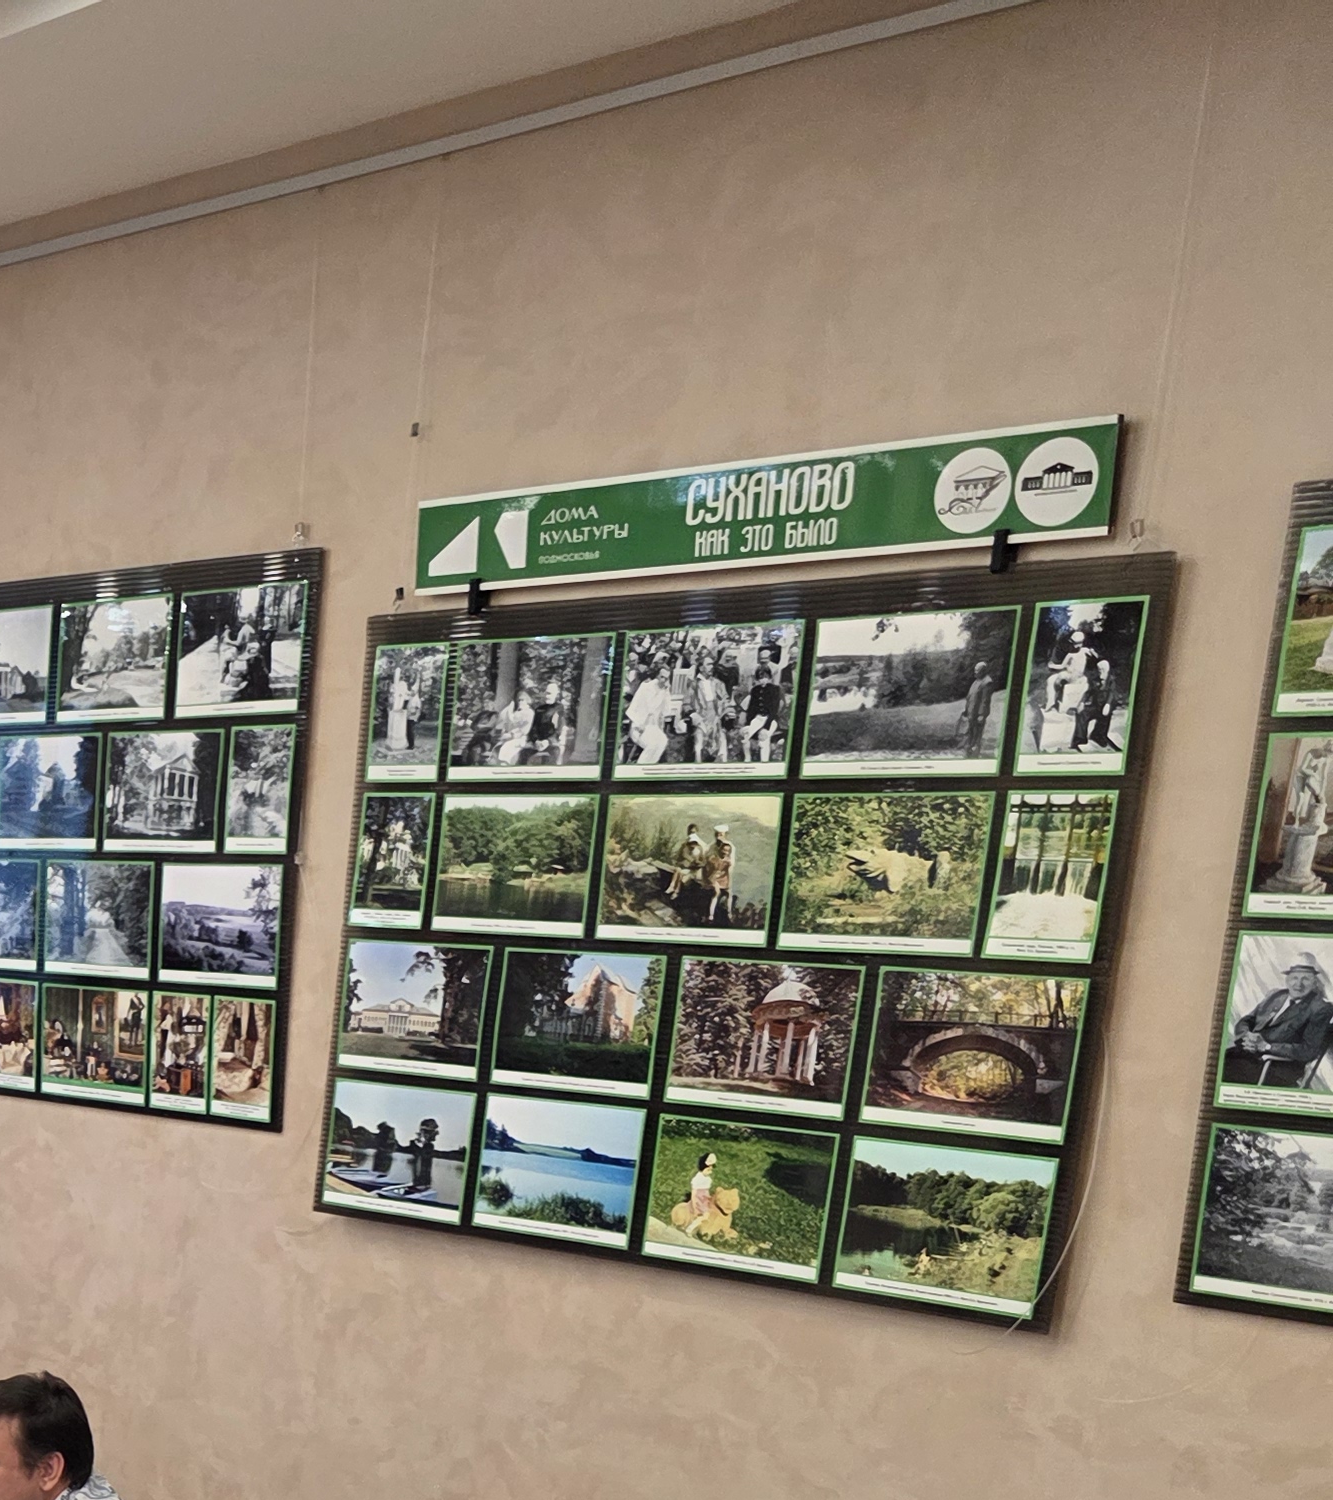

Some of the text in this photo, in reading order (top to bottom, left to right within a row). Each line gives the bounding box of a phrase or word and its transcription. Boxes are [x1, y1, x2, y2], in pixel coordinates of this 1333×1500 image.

[685, 461, 855, 526] СУХАНОВО
[540, 505, 599, 526] ДОМА
[539, 523, 629, 546] КУЛЬТУРЫ
[694, 517, 838, 557] КАК ЭТО БЫЛО
